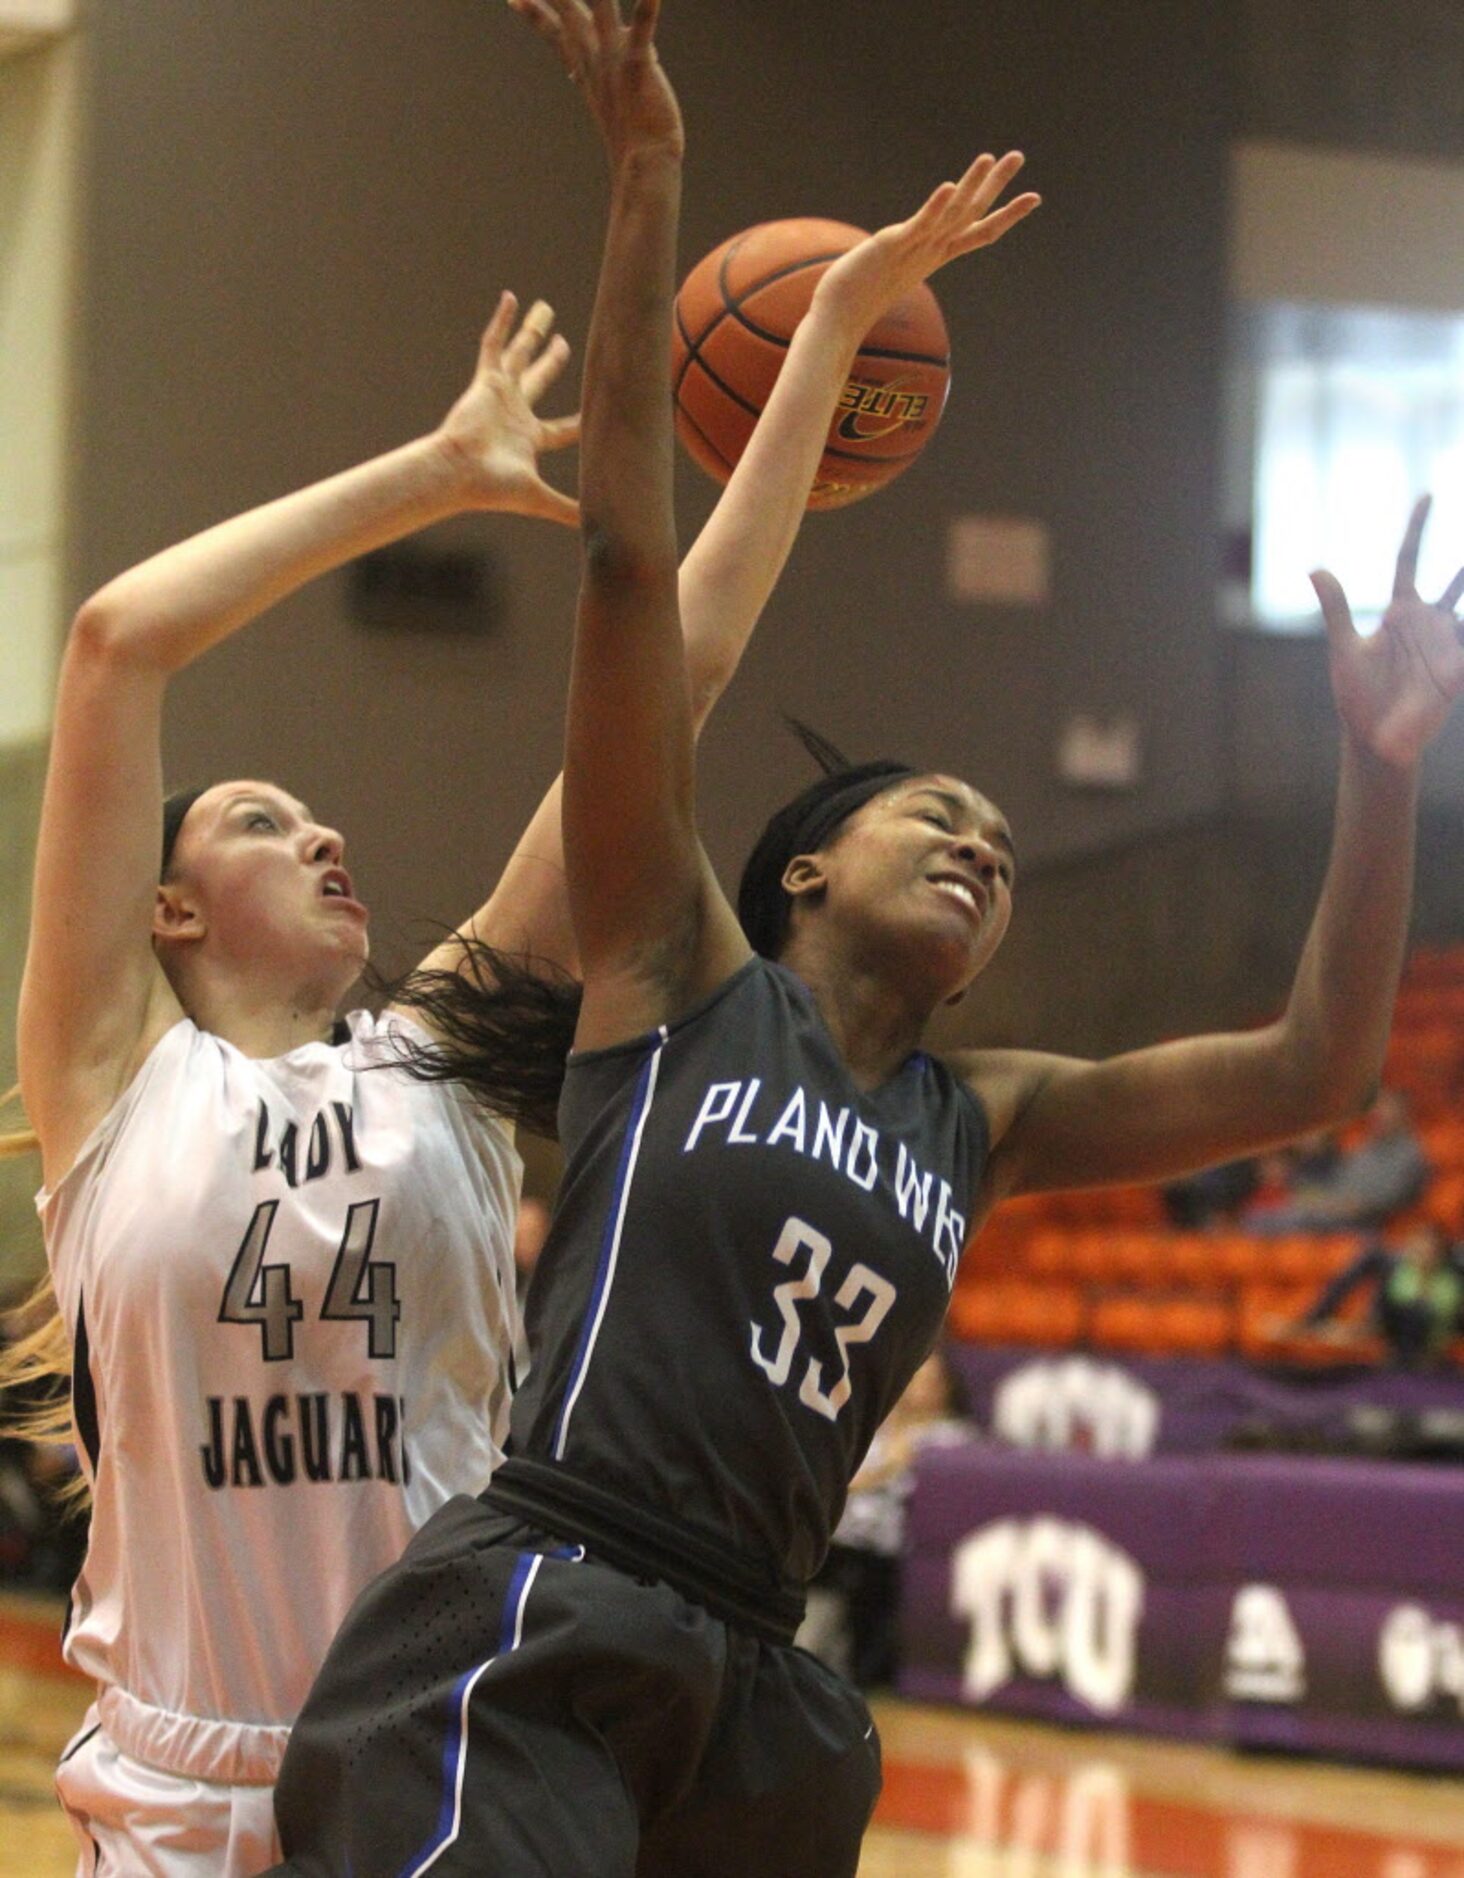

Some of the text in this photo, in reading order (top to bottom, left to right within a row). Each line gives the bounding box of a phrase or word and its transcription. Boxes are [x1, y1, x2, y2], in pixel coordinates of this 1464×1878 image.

[837, 382, 929, 420] ELITE
[251, 1095, 363, 1189] LADY
[683, 1077, 880, 1192] PLANO
[216, 1197, 403, 1363] 44
[749, 1215, 898, 1423] 33
